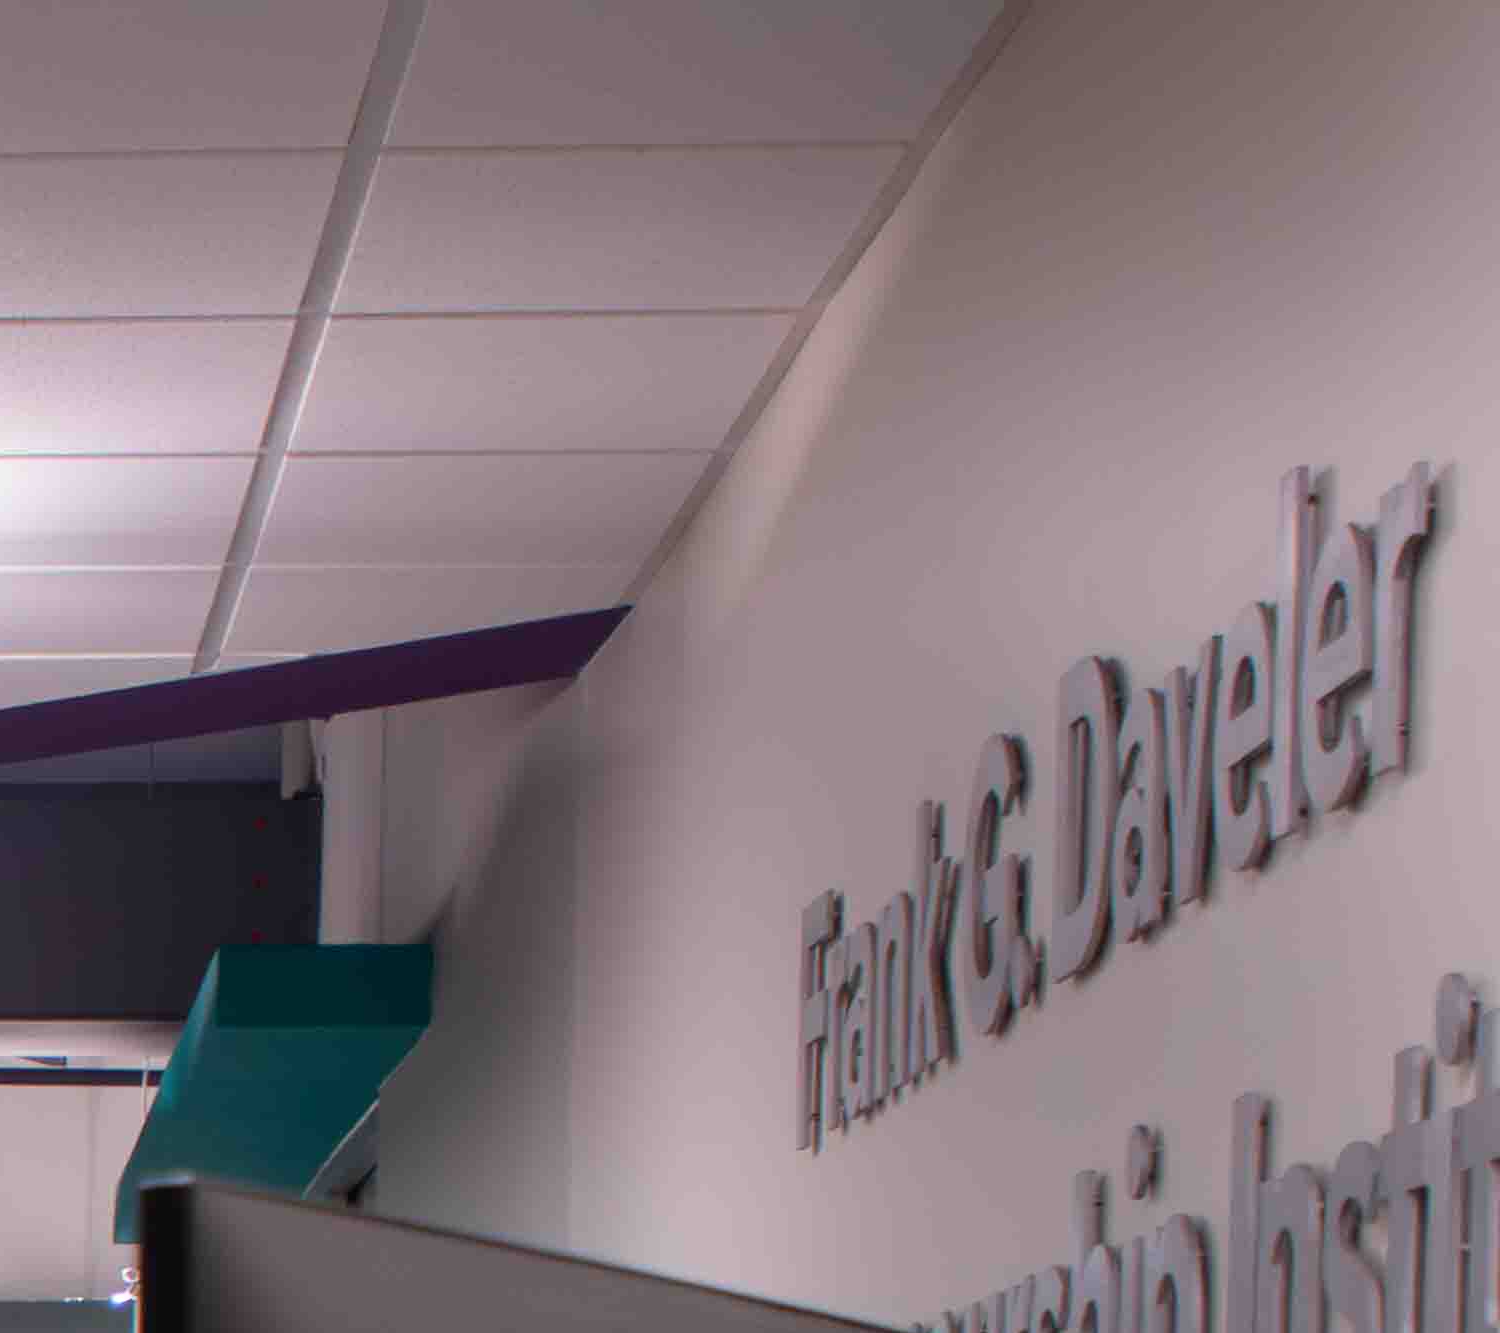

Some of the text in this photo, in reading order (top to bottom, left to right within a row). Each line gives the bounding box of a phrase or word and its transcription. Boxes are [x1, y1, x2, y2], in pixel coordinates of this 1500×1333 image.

[797, 462, 1432, 1153] Frank G. Daveler
